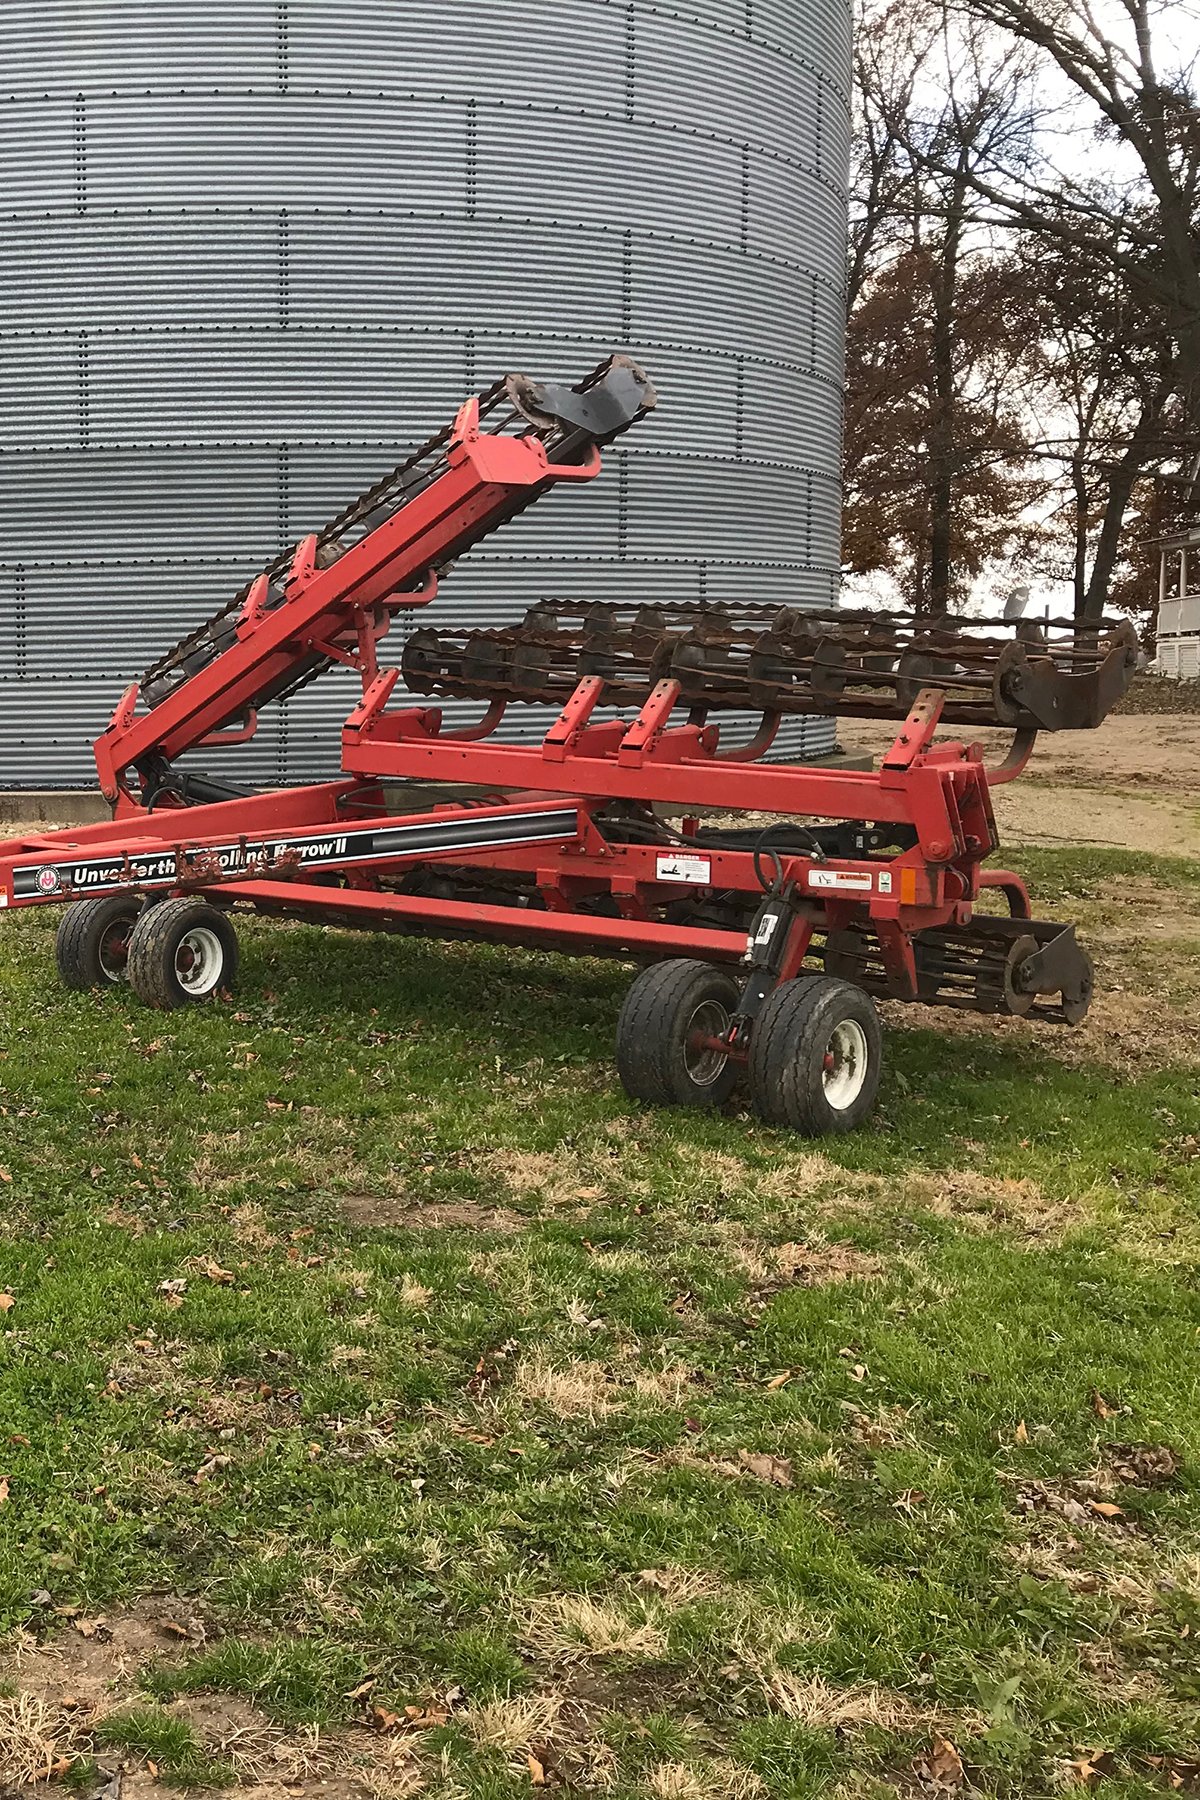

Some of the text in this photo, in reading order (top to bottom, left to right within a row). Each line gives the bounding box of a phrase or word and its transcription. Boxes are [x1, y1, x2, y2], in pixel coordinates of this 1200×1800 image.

[74, 858, 176, 884] Unveferth
[196, 849, 268, 870] olling
[273, 842, 333, 859] Hrow
